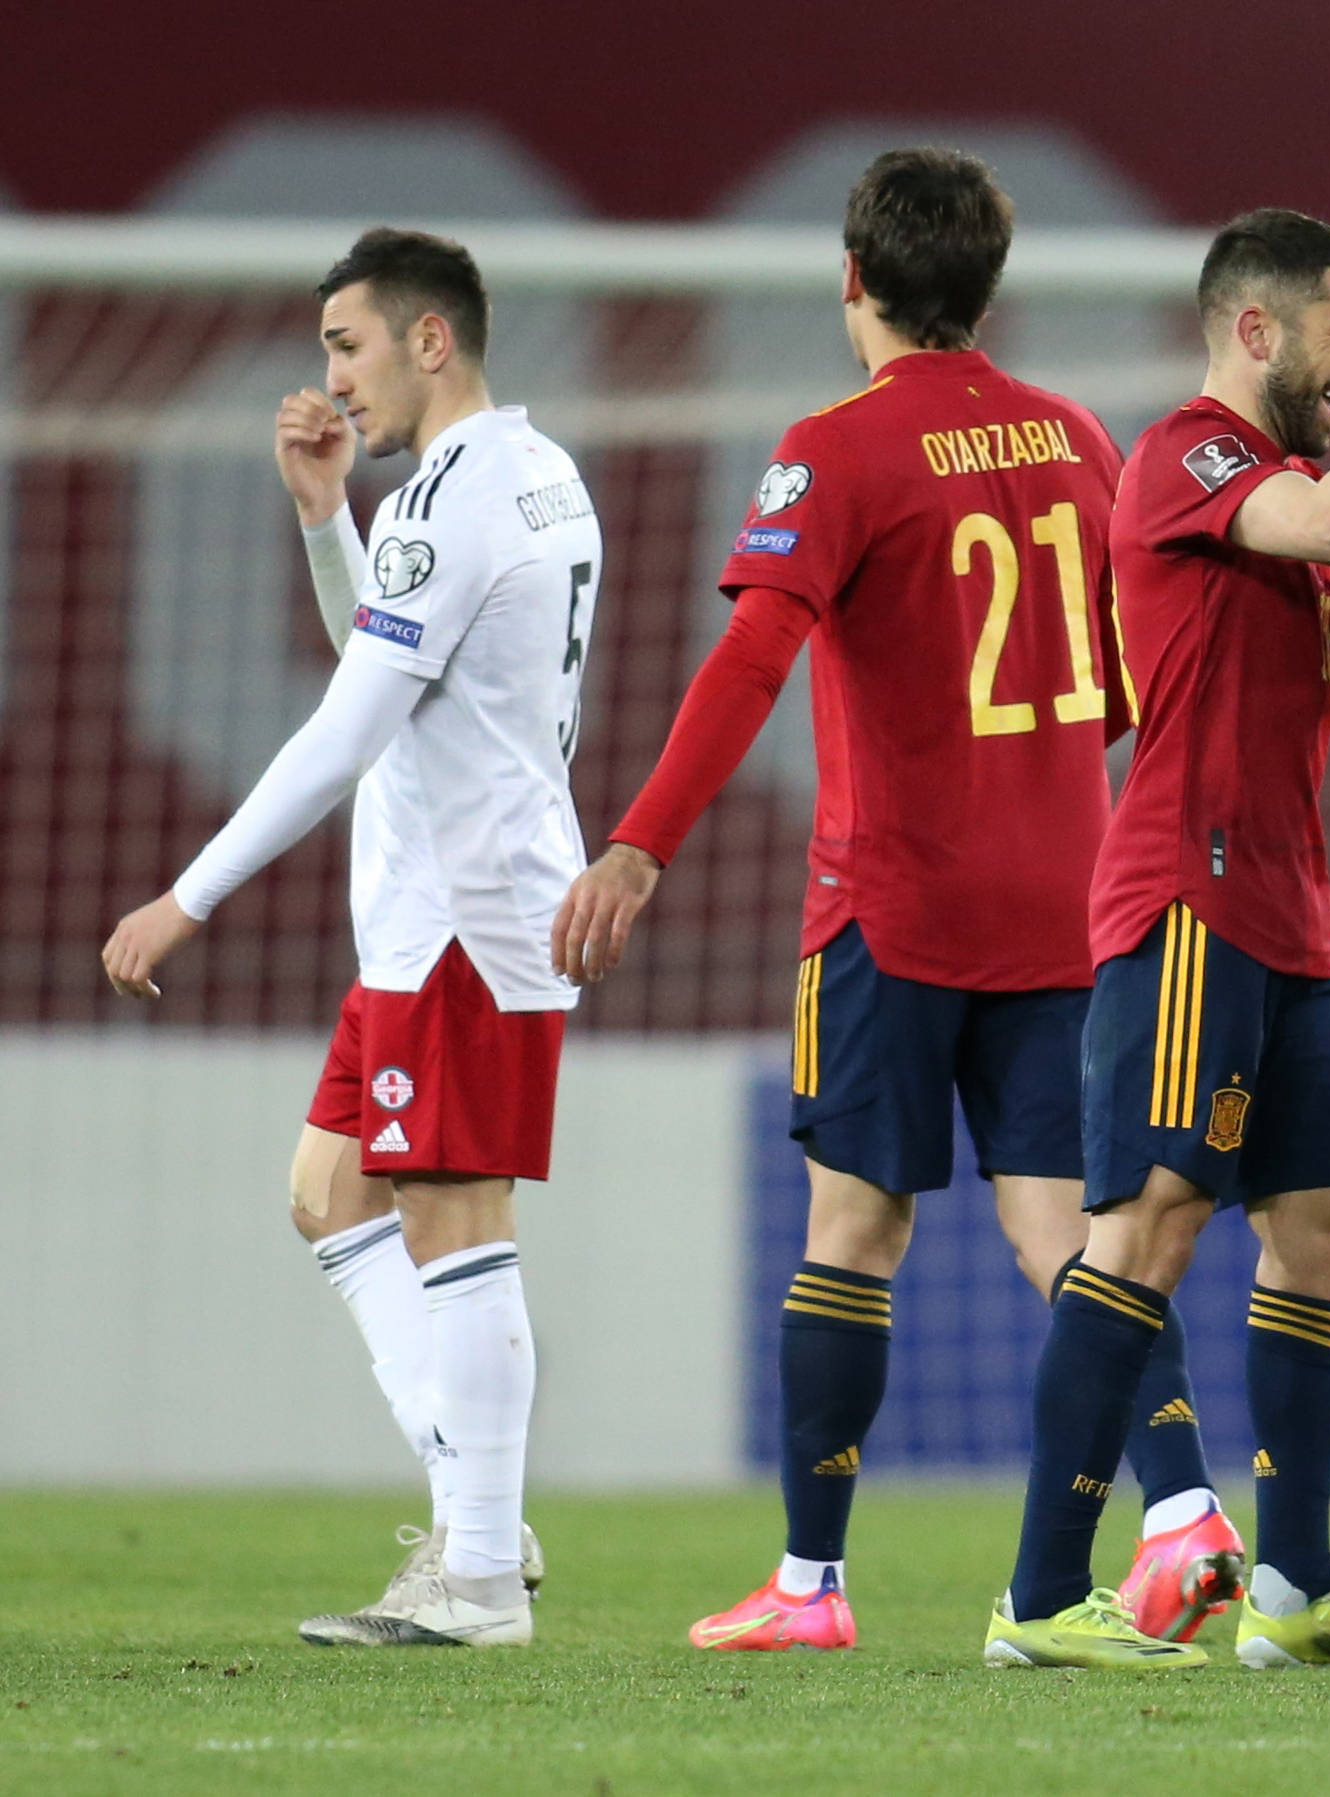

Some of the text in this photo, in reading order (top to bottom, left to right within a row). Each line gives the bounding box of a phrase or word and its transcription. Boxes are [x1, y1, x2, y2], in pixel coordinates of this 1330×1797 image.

[921, 419, 1082, 477] OYARZABAL
[748, 533, 796, 549] RESPECT
[368, 614, 422, 641] RESPECT
[952, 502, 1106, 737] 21
